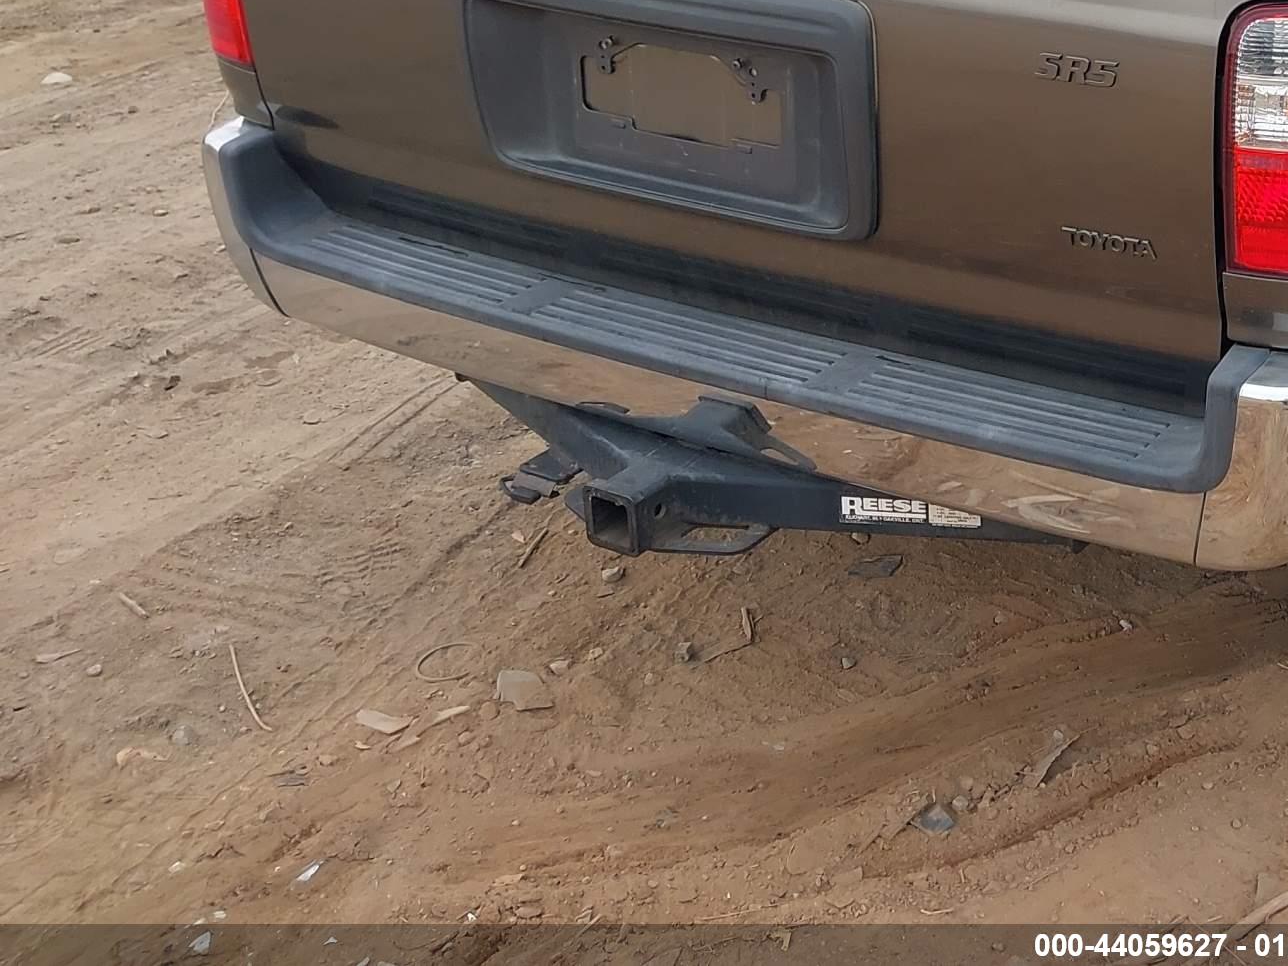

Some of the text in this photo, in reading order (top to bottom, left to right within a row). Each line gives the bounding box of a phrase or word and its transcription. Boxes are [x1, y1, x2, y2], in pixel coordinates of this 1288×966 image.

[1034, 51, 1121, 88] SR5
[1061, 225, 1159, 260] TOYOTA
[841, 496, 927, 515] REESE
